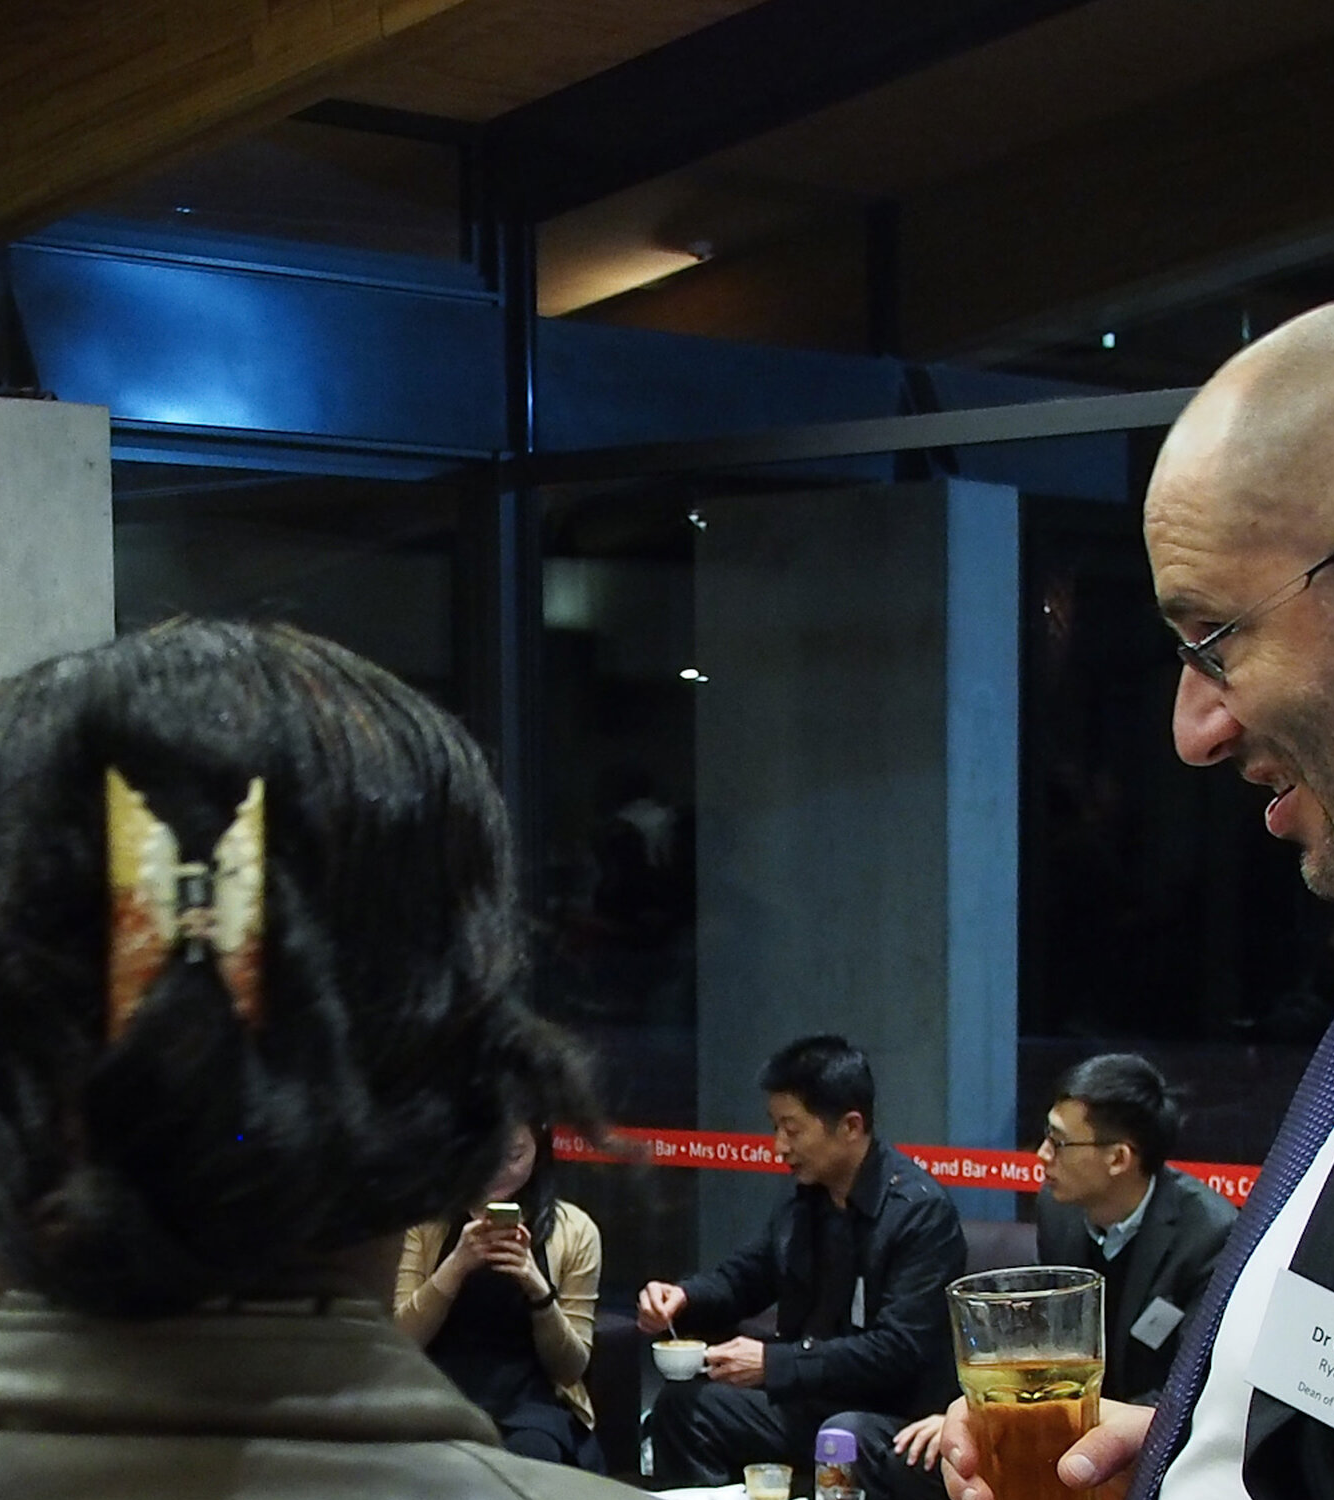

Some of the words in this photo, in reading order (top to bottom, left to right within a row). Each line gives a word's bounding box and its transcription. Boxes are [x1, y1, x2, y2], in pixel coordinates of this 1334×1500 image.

[655, 1139, 677, 1156] Bar
[689, 1141, 715, 1159] Mrs
[717, 1142, 738, 1161] O's
[741, 1144, 772, 1163] Cafe
[930, 1158, 959, 1176] and
[962, 1158, 988, 1178] Bar
[1000, 1161, 1030, 1182] Mrs
[1311, 1325, 1332, 1347] Dr
[1297, 1380, 1322, 1401] Dean
[1323, 1395, 1334, 1407] of
